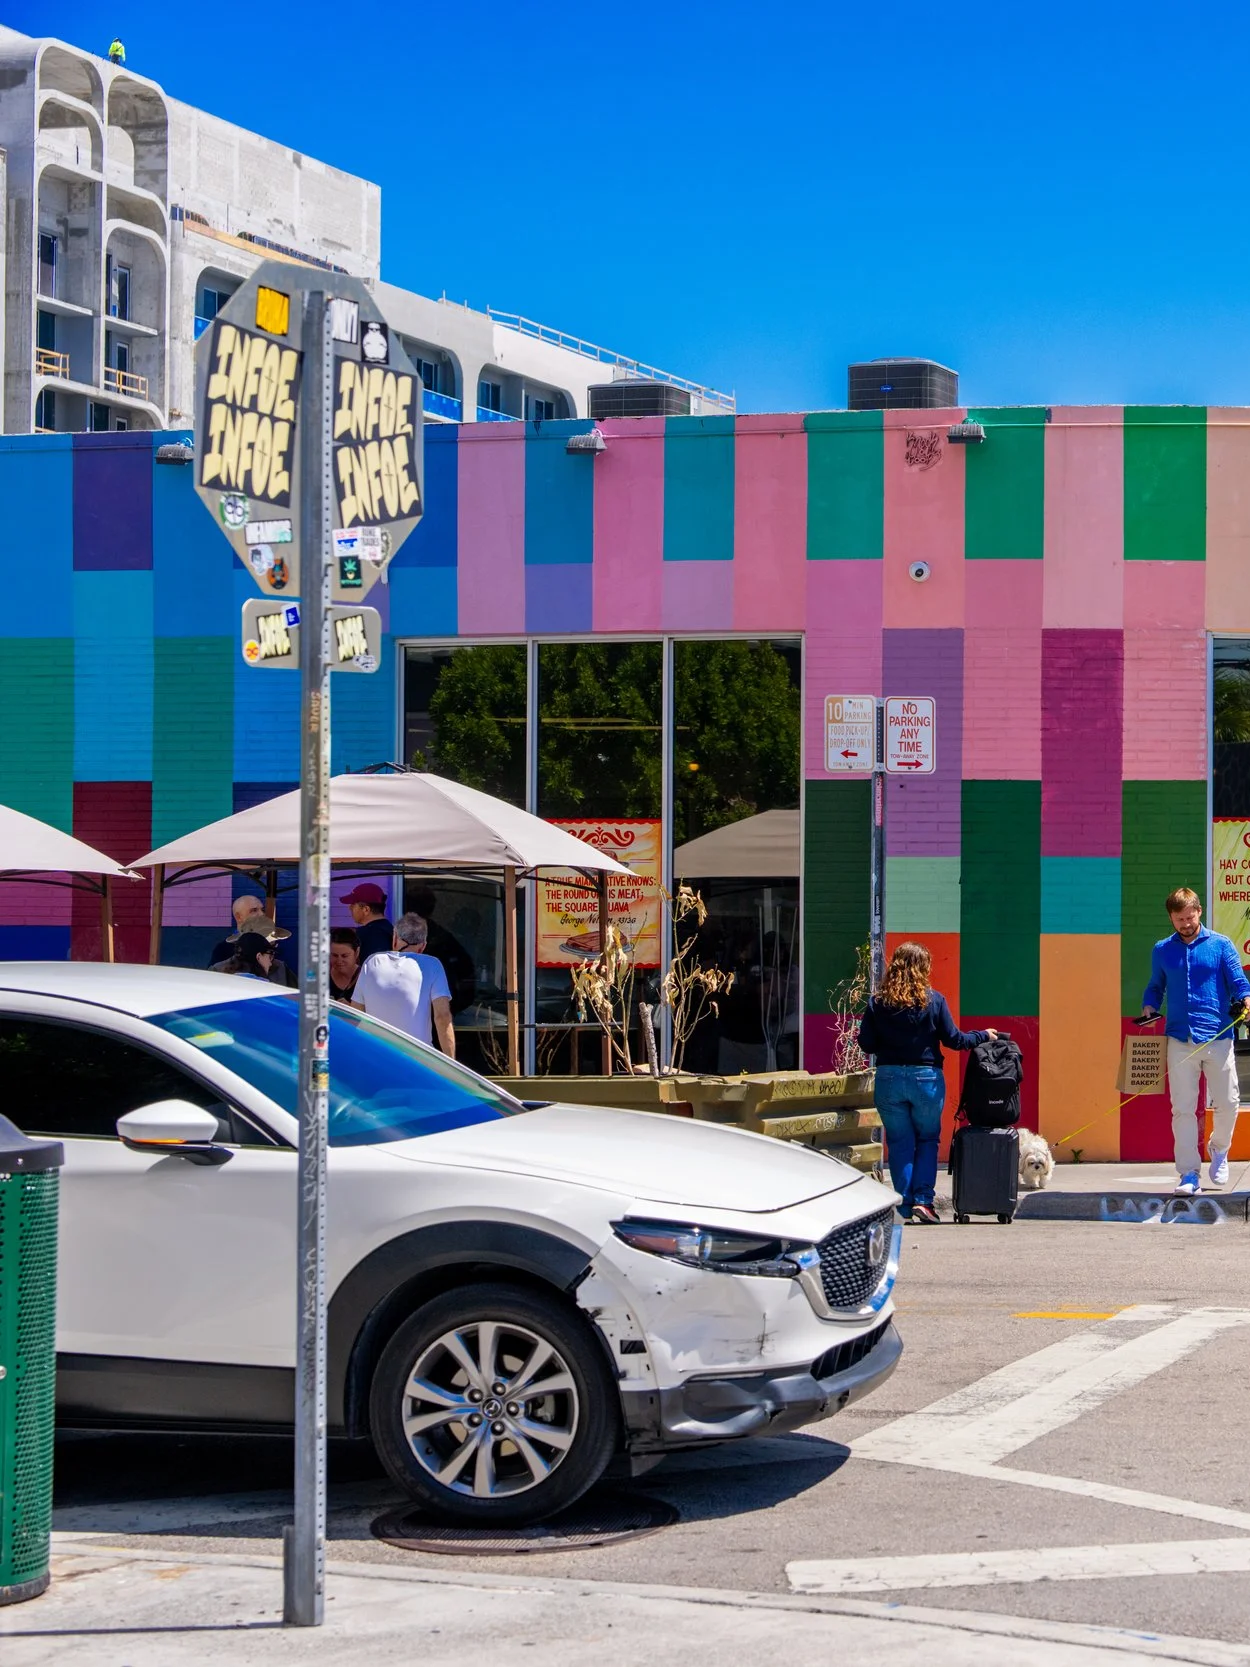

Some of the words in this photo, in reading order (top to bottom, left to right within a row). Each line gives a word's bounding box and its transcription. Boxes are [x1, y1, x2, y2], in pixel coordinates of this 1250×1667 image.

[828, 702, 842, 720] 10
[902, 704, 917, 714] NO
[844, 712, 871, 720] PARKING
[889, 716, 930, 727] PARKING
[900, 728, 919, 739] ANY
[897, 741, 922, 752] TIME
[1219, 859, 1237, 870] HAY
[606, 876, 626, 886] ATIVE
[1225, 875, 1244, 885] BUT
[546, 890, 562, 899] THE
[563, 890, 589, 899] ROUND
[608, 889, 615, 899] IS
[546, 902, 562, 912] THE
[564, 902, 598, 912] SQUARE
[608, 902, 630, 912] UAVA
